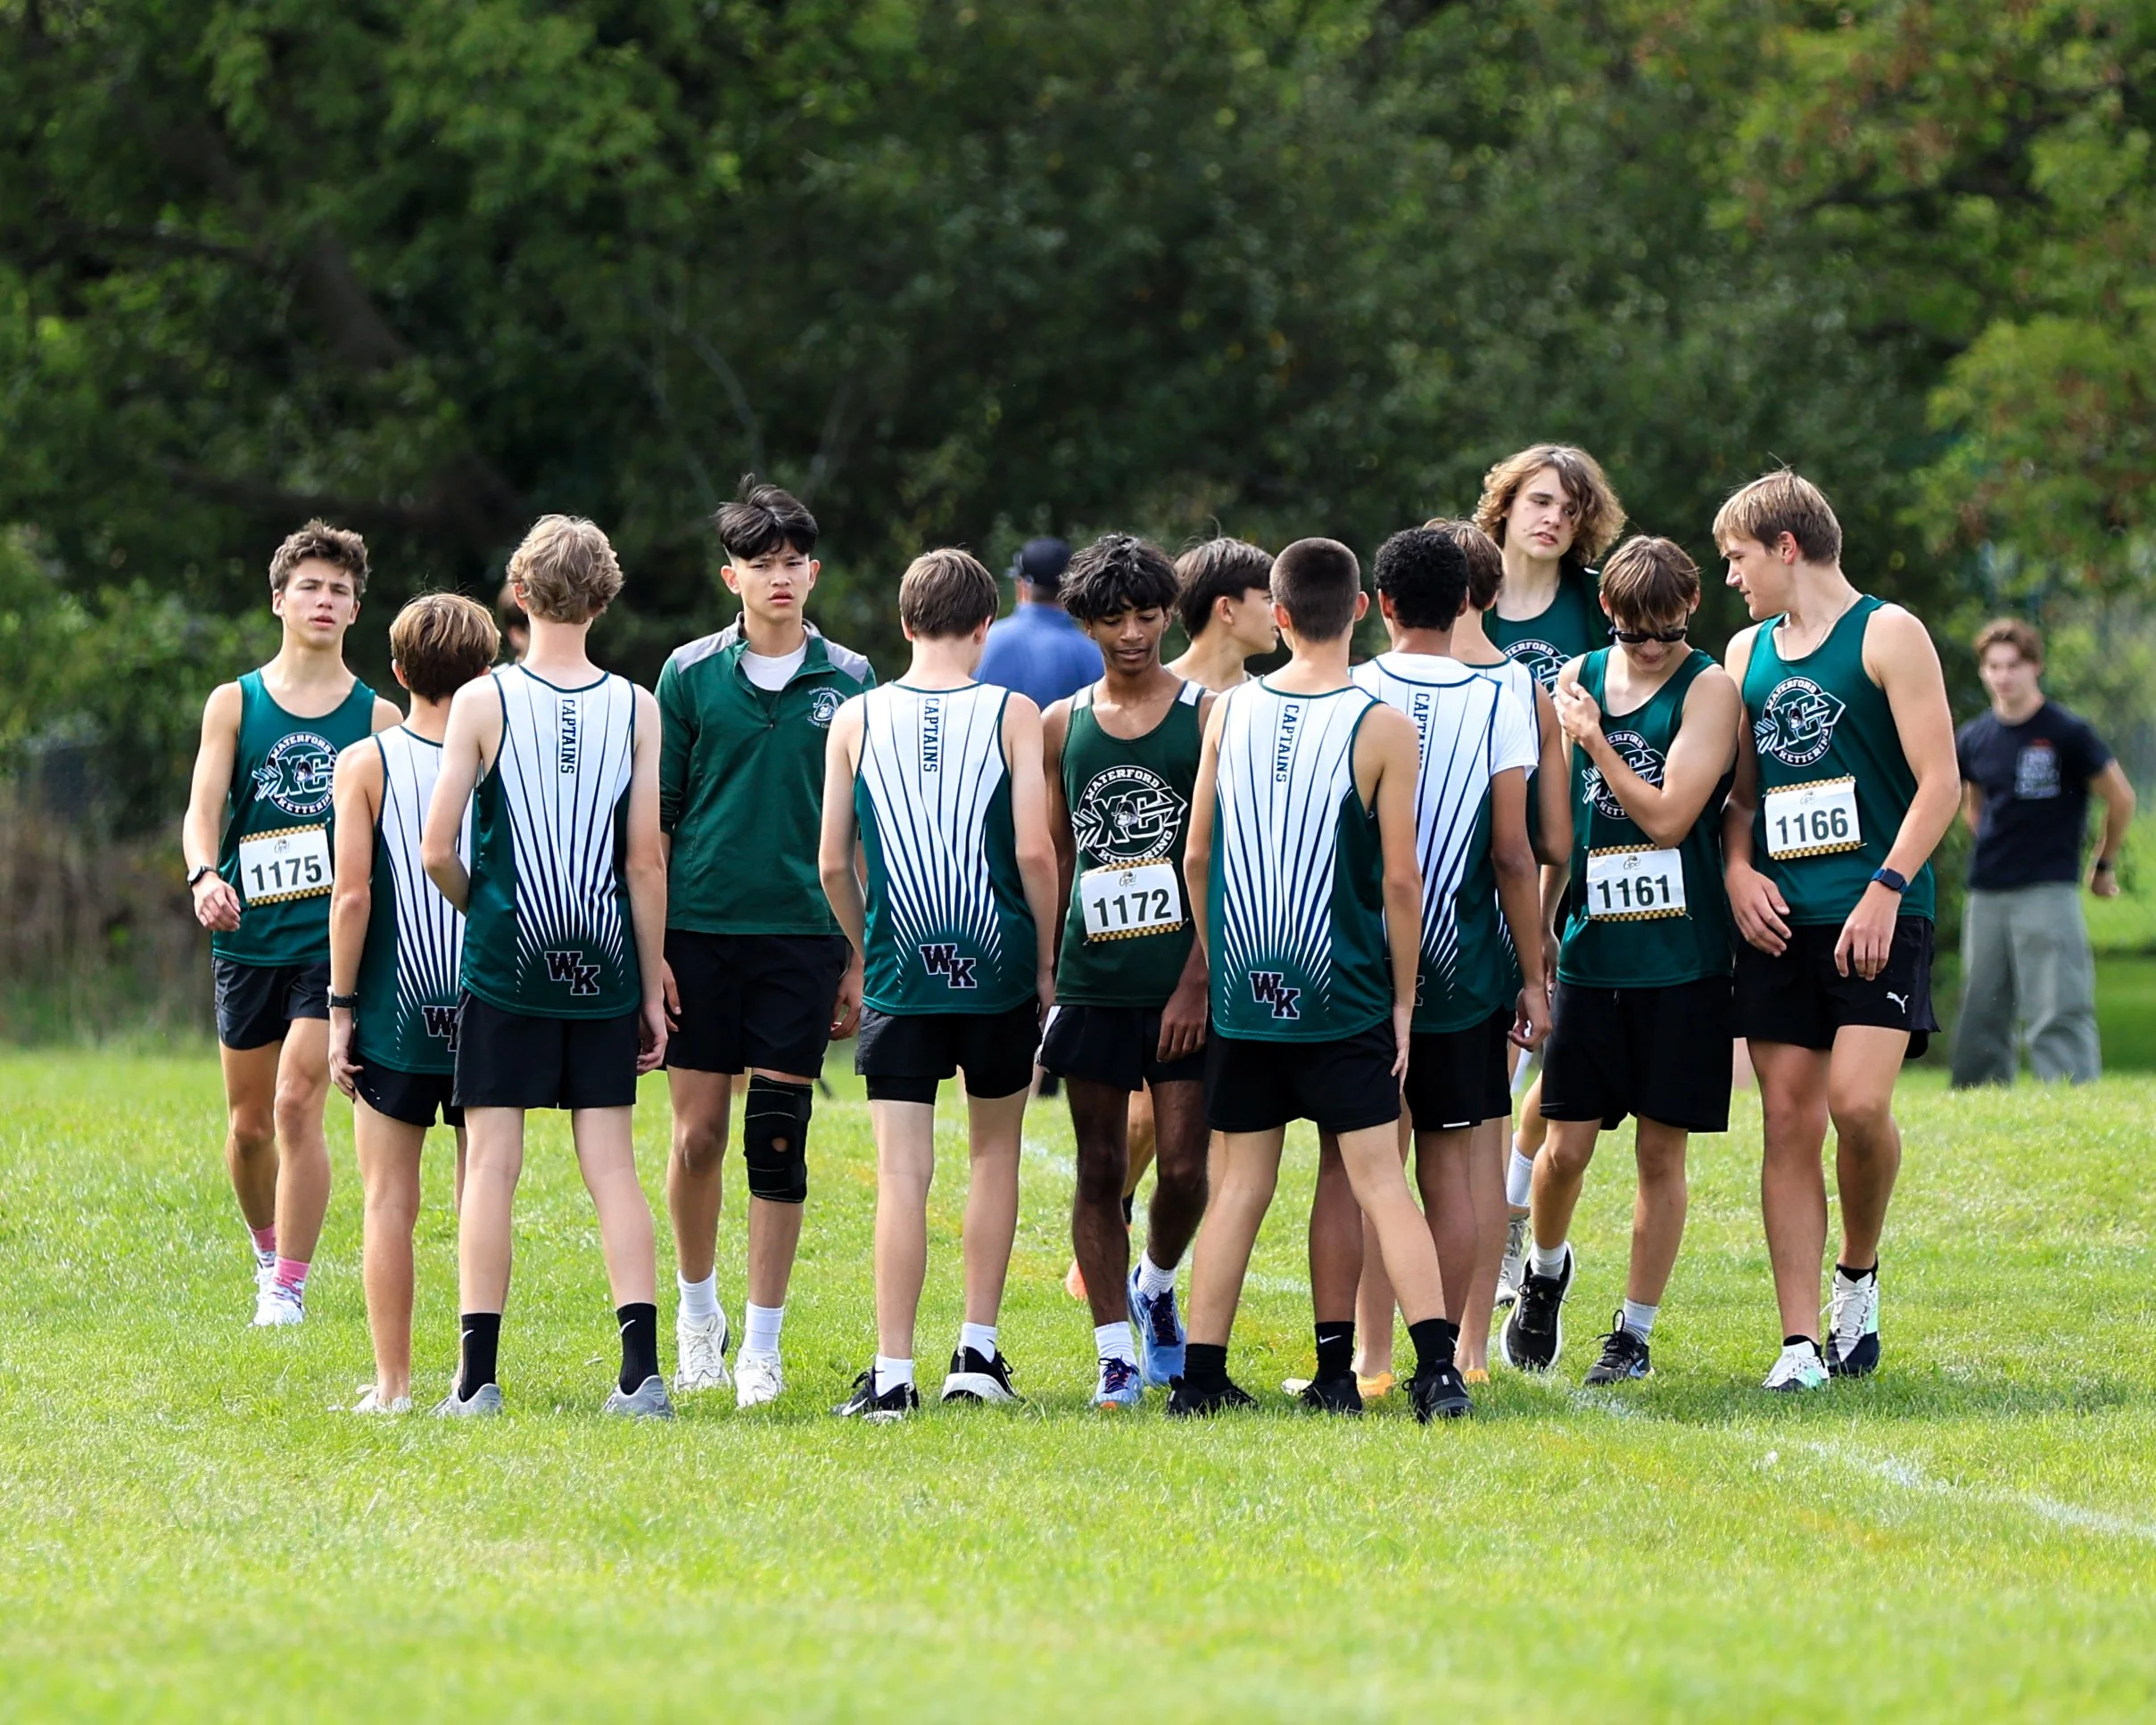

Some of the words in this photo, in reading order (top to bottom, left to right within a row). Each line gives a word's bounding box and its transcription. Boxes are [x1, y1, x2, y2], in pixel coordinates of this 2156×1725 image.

[1505, 642, 1554, 656] TERFORD
[1766, 680, 1817, 711] WATERFORD
[270, 734, 331, 758] WATERFORD
[560, 699, 577, 774] CAPTAINS
[922, 697, 940, 772] CAPTAINS
[1276, 704, 1300, 782] CAPTAINS
[1607, 733, 1643, 748] ERFORD
[1779, 728, 1830, 763] KETTERING
[1085, 768, 1160, 801] WATERFORD
[1776, 807, 1849, 845] 1166
[251, 854, 322, 891] 1175
[1093, 888, 1172, 928] 1172
[1597, 874, 1671, 909] 1161
[544, 951, 600, 995] WK
[919, 943, 978, 988] WK
[1248, 970, 1301, 1019] WK
